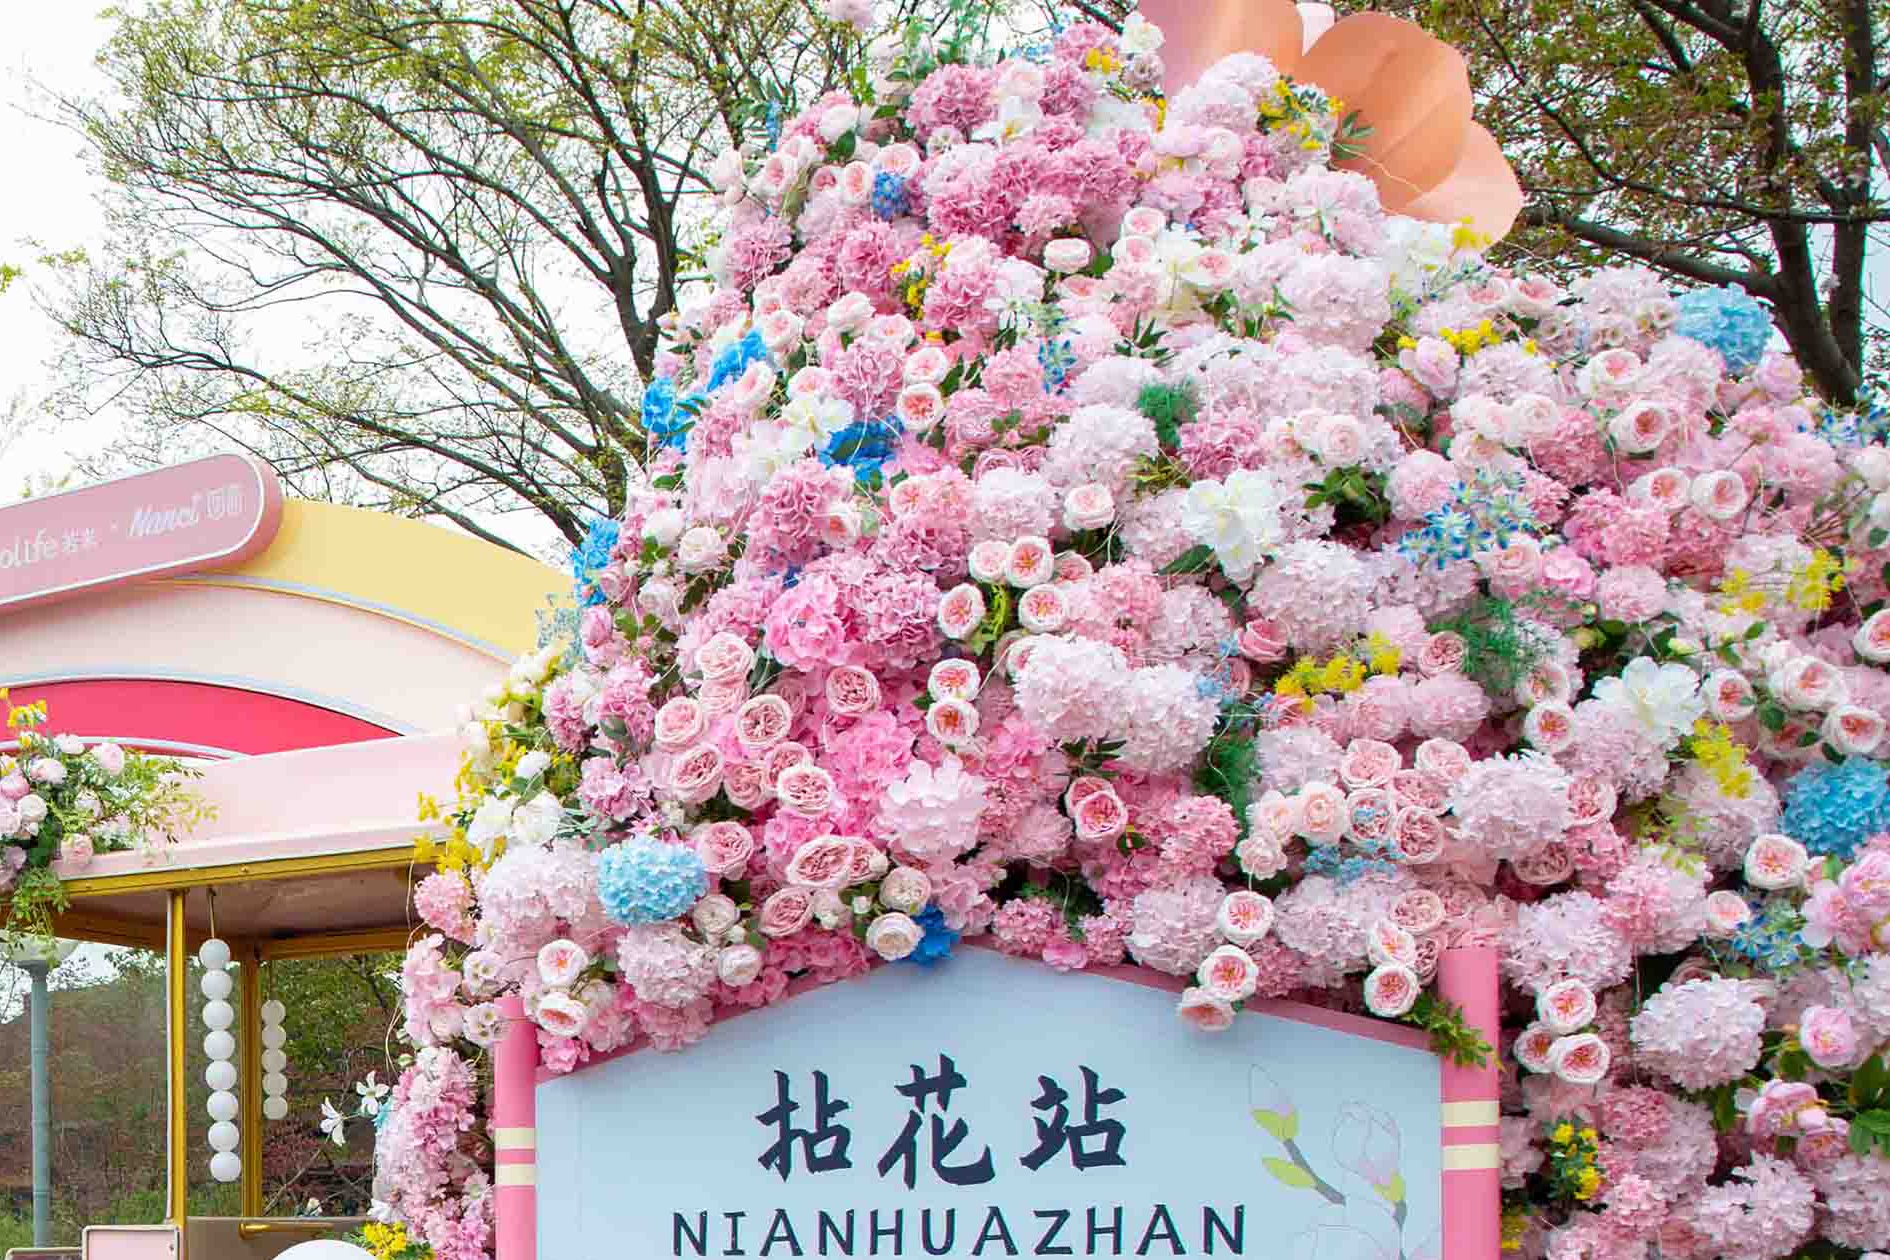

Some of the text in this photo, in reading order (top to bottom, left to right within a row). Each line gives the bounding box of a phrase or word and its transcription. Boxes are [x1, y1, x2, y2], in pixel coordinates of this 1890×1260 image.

[756, 1054, 1126, 1189] 拈花站
[672, 1203, 1245, 1257] NIANHUAZHAN
